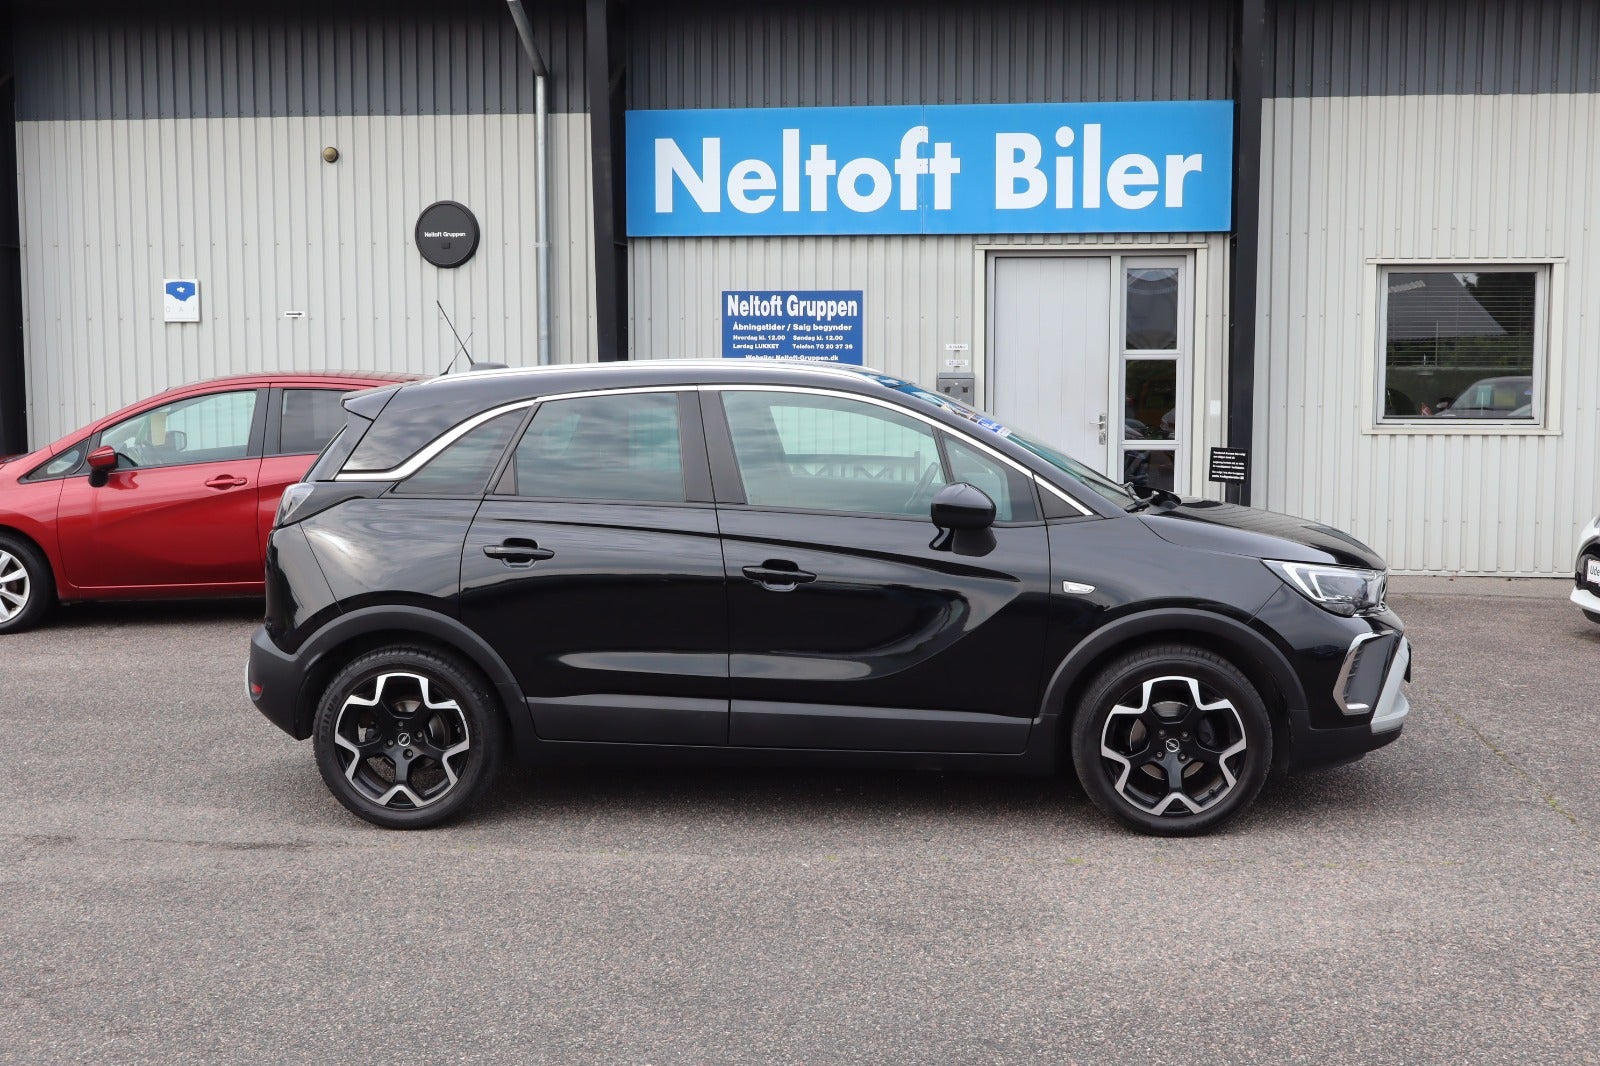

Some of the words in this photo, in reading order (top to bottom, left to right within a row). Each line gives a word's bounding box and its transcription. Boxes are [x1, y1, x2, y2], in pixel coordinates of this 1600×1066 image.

[654, 126, 961, 214] Neltoft
[995, 123, 1203, 210] Biler
[727, 294, 783, 317] Neltoft
[786, 294, 858, 321] Gruppen
[732, 321, 786, 332] Åbningstider
[792, 323, 811, 332] Salg
[812, 323, 852, 332] begynder
